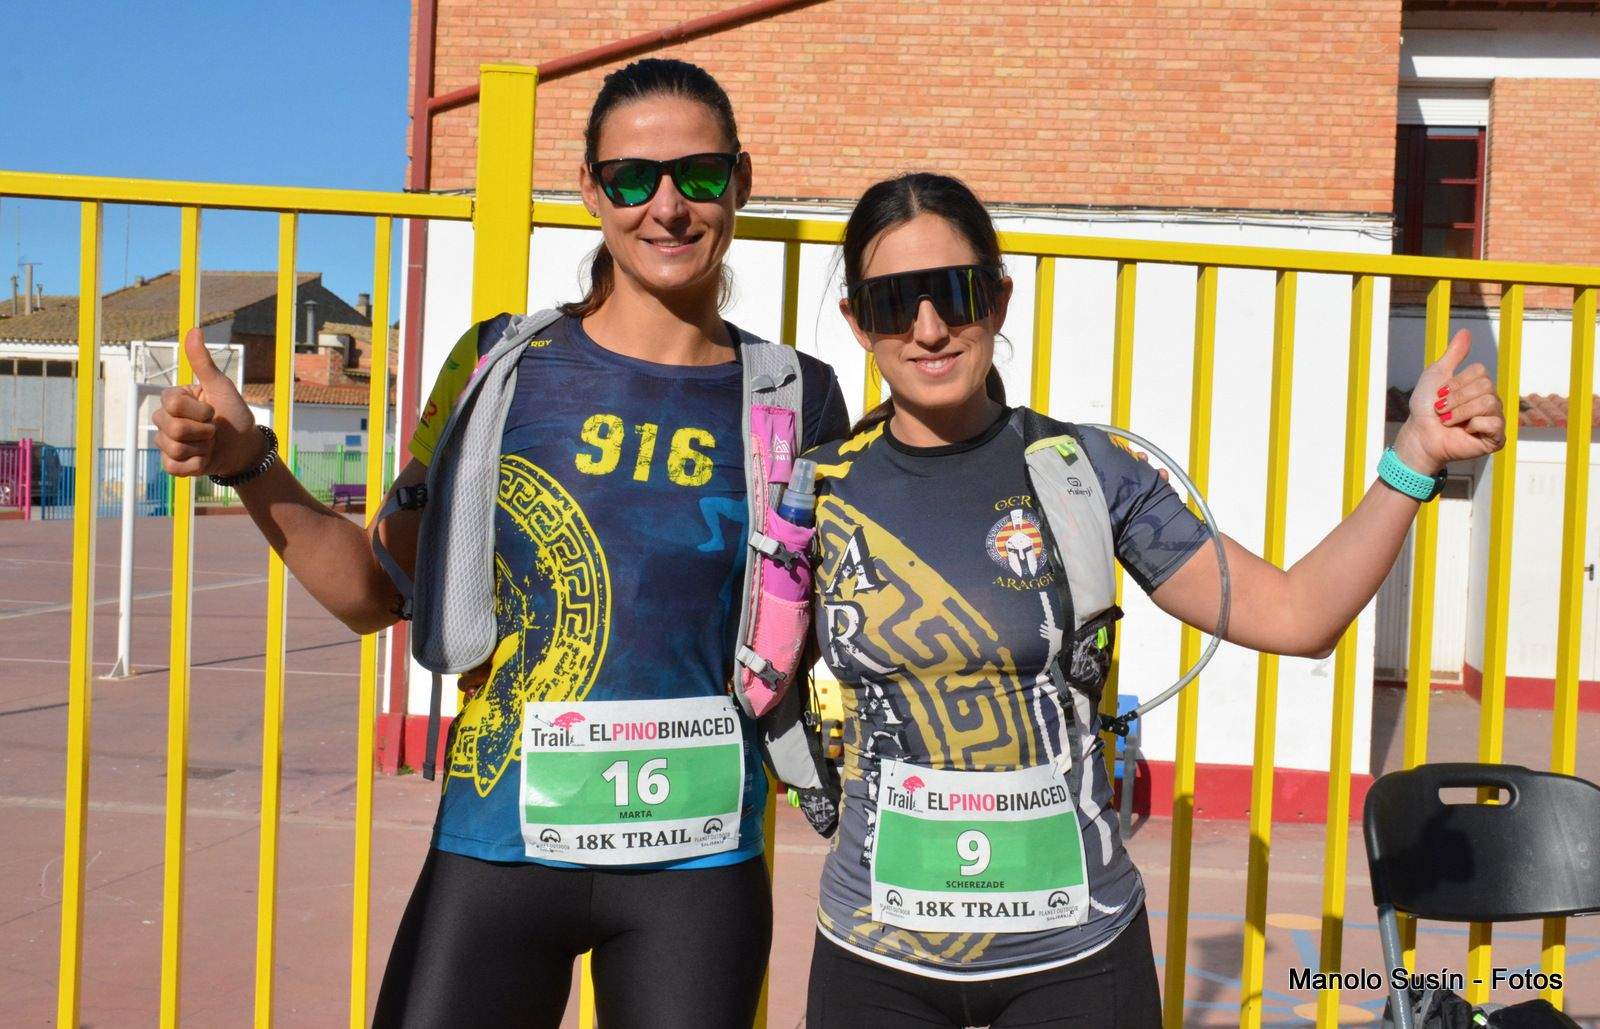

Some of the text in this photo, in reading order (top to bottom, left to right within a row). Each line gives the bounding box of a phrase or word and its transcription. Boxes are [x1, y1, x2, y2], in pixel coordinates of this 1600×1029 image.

[575, 413, 718, 488] 916
[993, 495, 1033, 511] OCR
[531, 727, 571, 748] Trail
[600, 757, 671, 808] 16
[886, 786, 915, 812] Trail
[619, 809, 653, 820] MARTA
[576, 832, 617, 851] 18K
[622, 828, 693, 849] TRAIL
[955, 828, 992, 877] 9
[945, 880, 1006, 889] SCHEREZADE
[915, 900, 956, 918] 18K
[962, 901, 1036, 918] TRAIL
